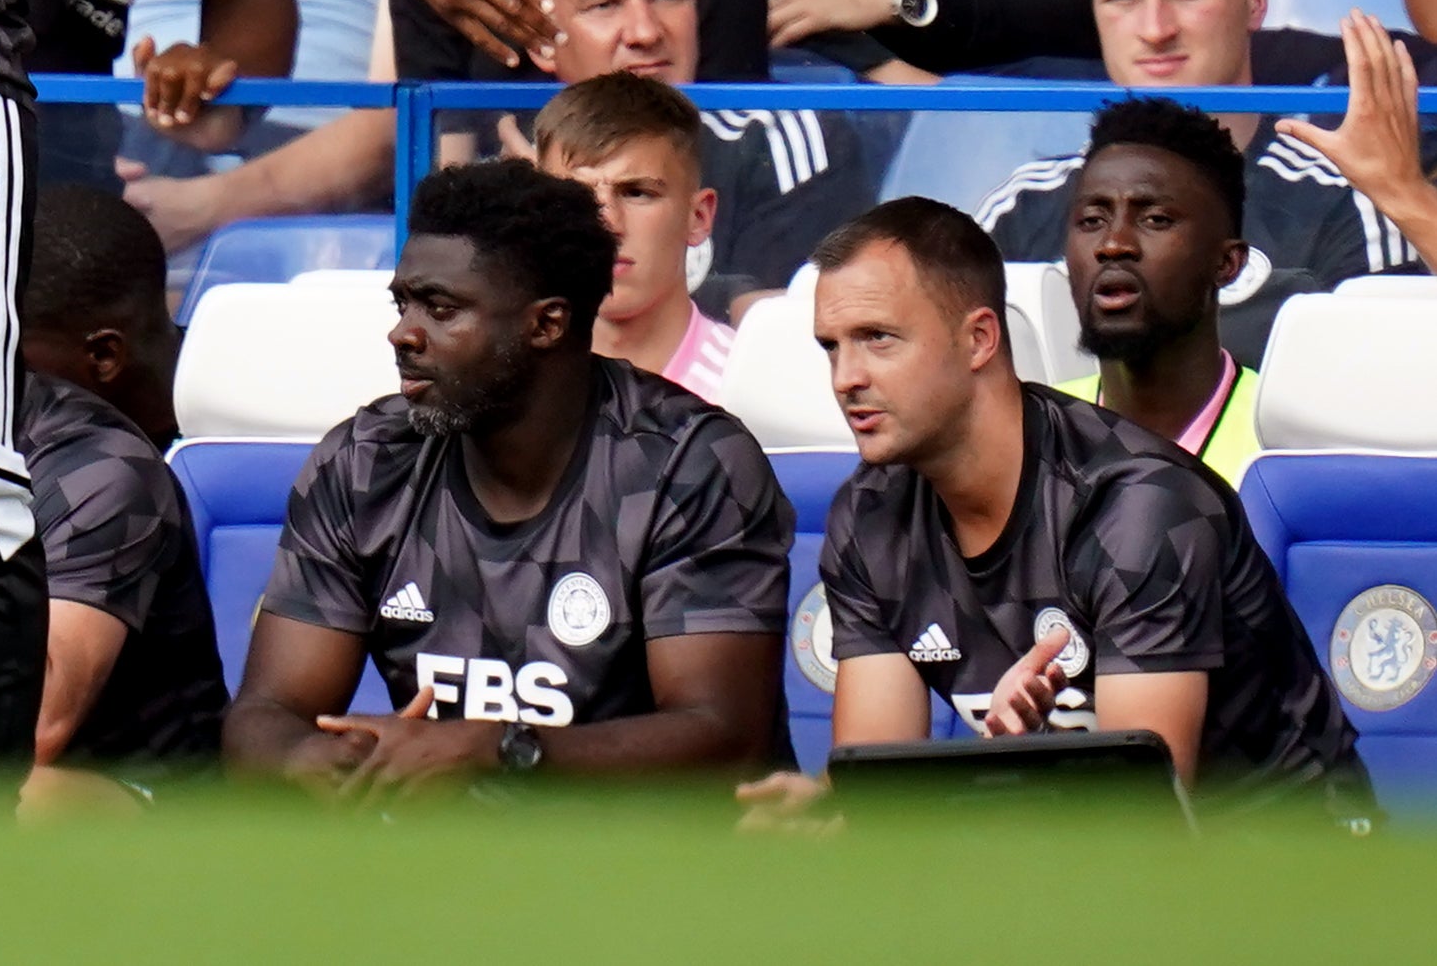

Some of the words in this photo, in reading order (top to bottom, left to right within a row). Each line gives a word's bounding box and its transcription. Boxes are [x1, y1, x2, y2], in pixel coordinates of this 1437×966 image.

[380, 605, 435, 623] adidas
[908, 647, 962, 663] adidas
[416, 652, 574, 728] FBS
